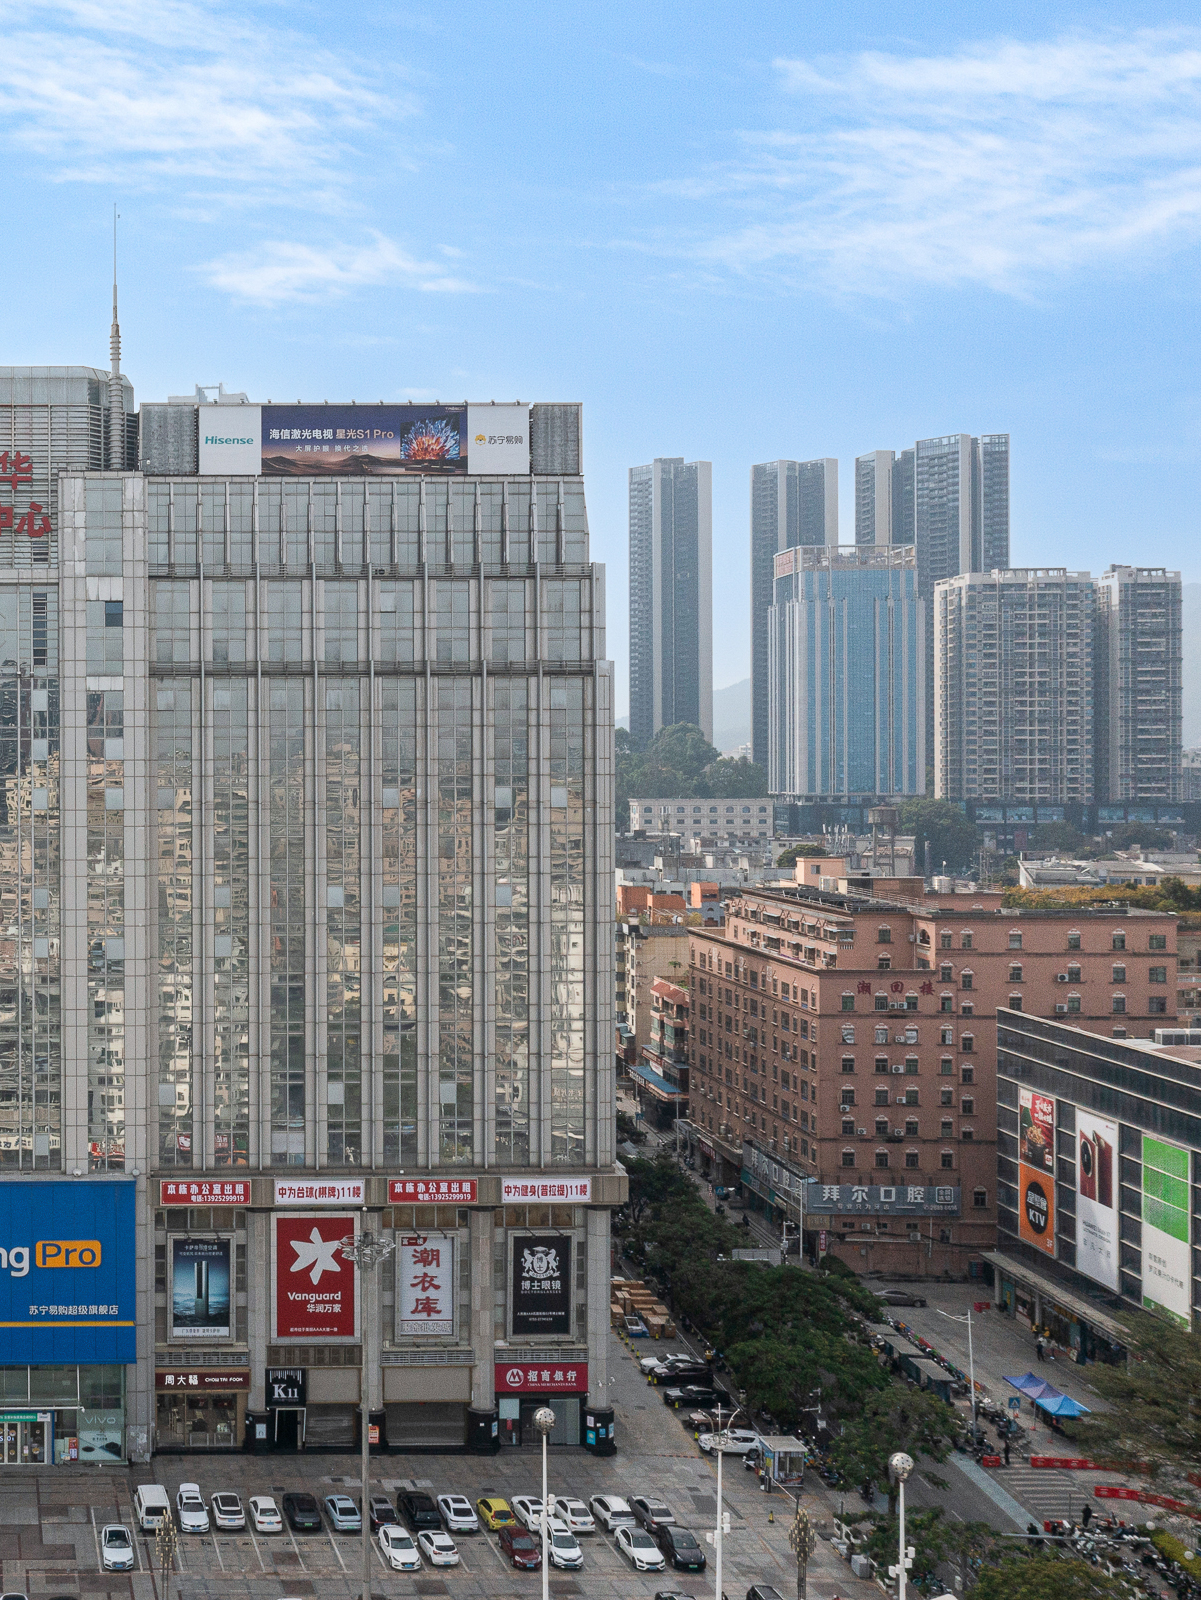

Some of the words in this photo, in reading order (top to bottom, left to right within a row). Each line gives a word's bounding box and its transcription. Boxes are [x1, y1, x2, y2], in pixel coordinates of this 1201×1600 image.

[204, 435, 254, 445] Hisense
[269, 428, 333, 440] 海信激光电视
[336, 428, 371, 440] 星光S1
[373, 429, 394, 439] Pro
[487, 435, 524, 445] 苏宁易购
[167, 1183, 244, 1194] 本栋办公室出租
[278, 1186, 361, 1200] 中为台球(棋牌)11楼
[394, 1182, 471, 1193] 本栋办公室出租
[504, 1184, 588, 1199] 中为健身(普拉提)11楼
[417, 1193, 471, 1201] 电话:13925299919
[822, 1185, 925, 1203] 拜尔口腔
[1028, 1211, 1047, 1227] KTV
[41, 1243, 97, 1266] Pro
[536, 1255, 544, 1272] 博士
[410, 1247, 443, 1318] 潮衣库
[521, 1280, 562, 1290] 博士眼镜
[287, 1291, 342, 1303] Vanguard
[28, 1305, 119, 1316] 苏宁易购超级旗舰店
[306, 1303, 342, 1313] 华润万家
[164, 1374, 199, 1386] 周大福
[527, 1369, 577, 1382] 招商银行
[272, 1383, 299, 1399] K11
[84, 1415, 117, 1425] vivo
